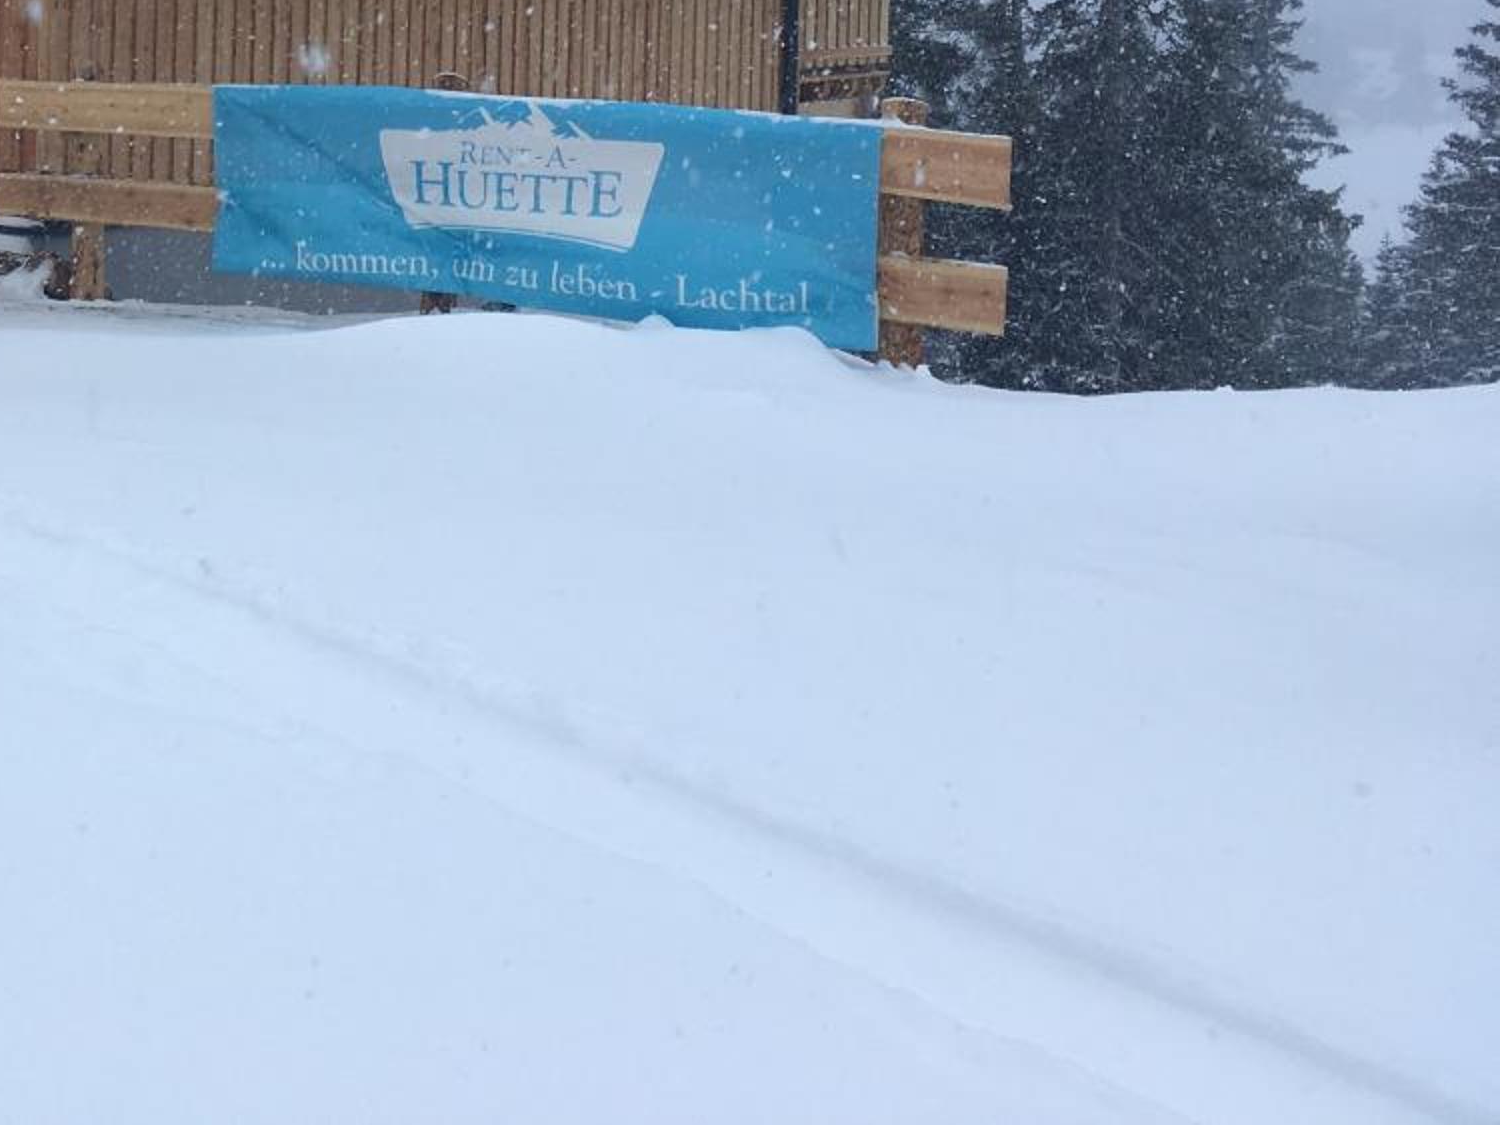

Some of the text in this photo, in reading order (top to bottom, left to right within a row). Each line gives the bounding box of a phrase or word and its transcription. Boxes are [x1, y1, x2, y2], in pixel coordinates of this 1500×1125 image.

[409, 159, 624, 218] HUETTE
[296, 240, 439, 278] kommen,
[452, 255, 495, 282] um
[504, 264, 539, 289] zu
[550, 260, 640, 301] leben
[675, 273, 810, 314] Lachtal
